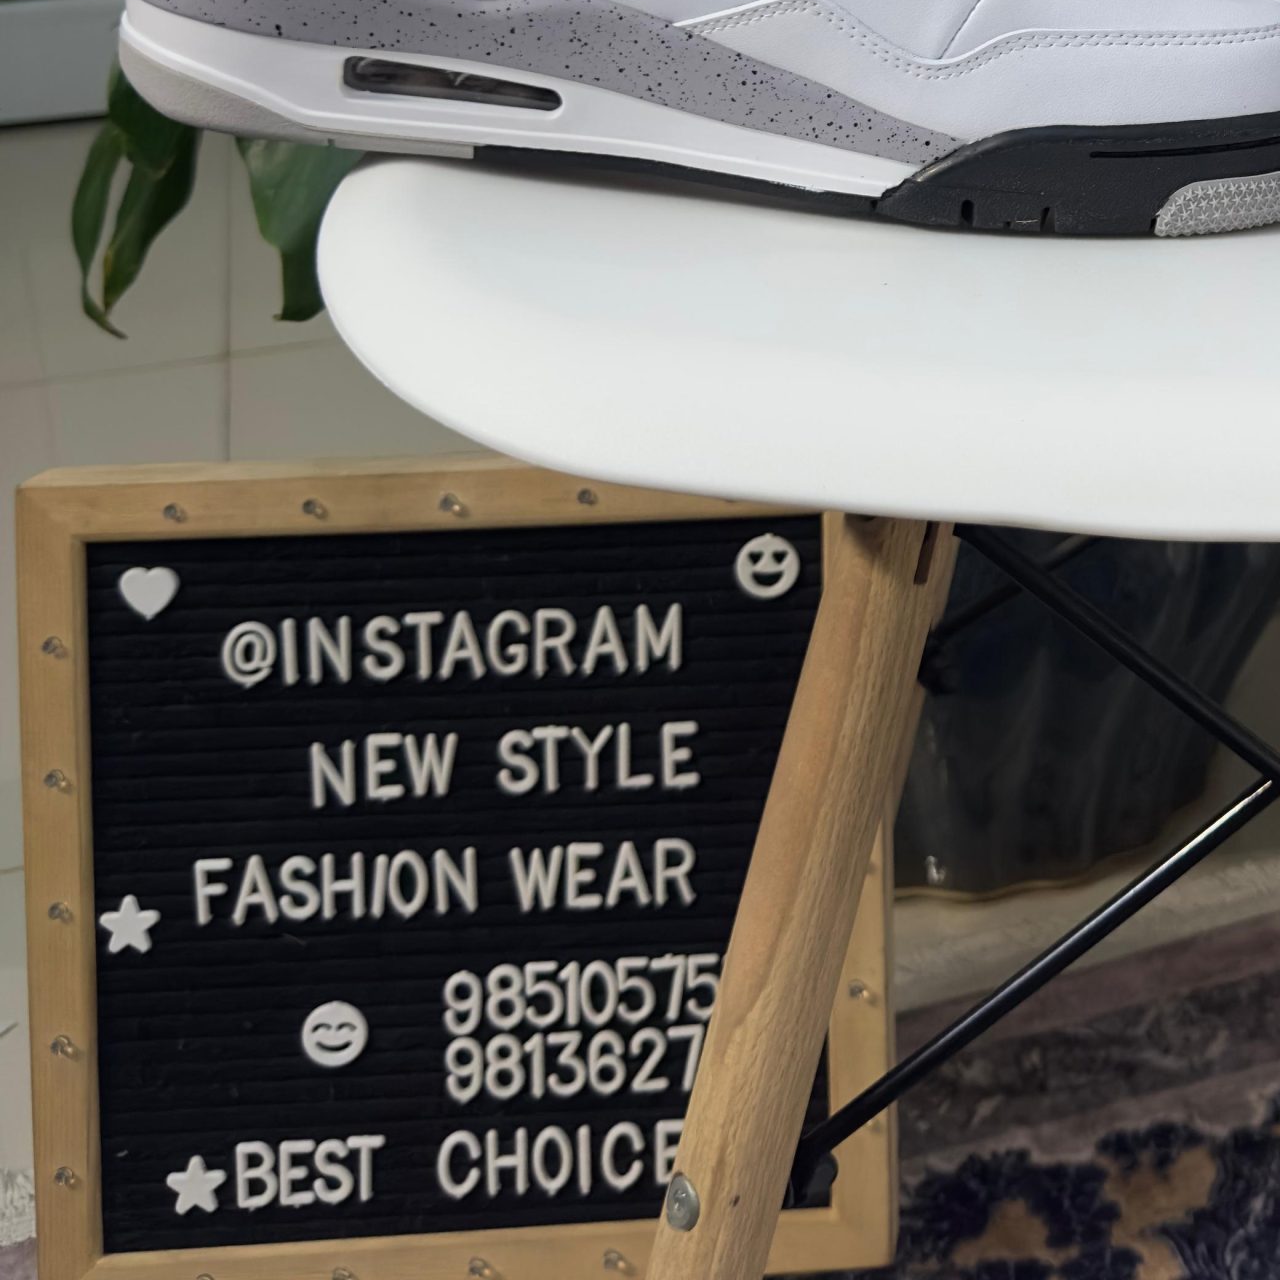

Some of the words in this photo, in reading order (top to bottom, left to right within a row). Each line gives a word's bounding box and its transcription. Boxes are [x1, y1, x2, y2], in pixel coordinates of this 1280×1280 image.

[221, 602, 684, 689] @INSTAGRAM
[309, 731, 458, 808] NEW
[497, 720, 700, 795] STYLE
[193, 846, 479, 927] FASHION
[509, 837, 697, 913] WEAR
[442, 952, 725, 1036] 98510575
[444, 1023, 705, 1104] 9813627
[234, 1134, 386, 1211] BEST
[436, 1119, 684, 1200] CHOICE
